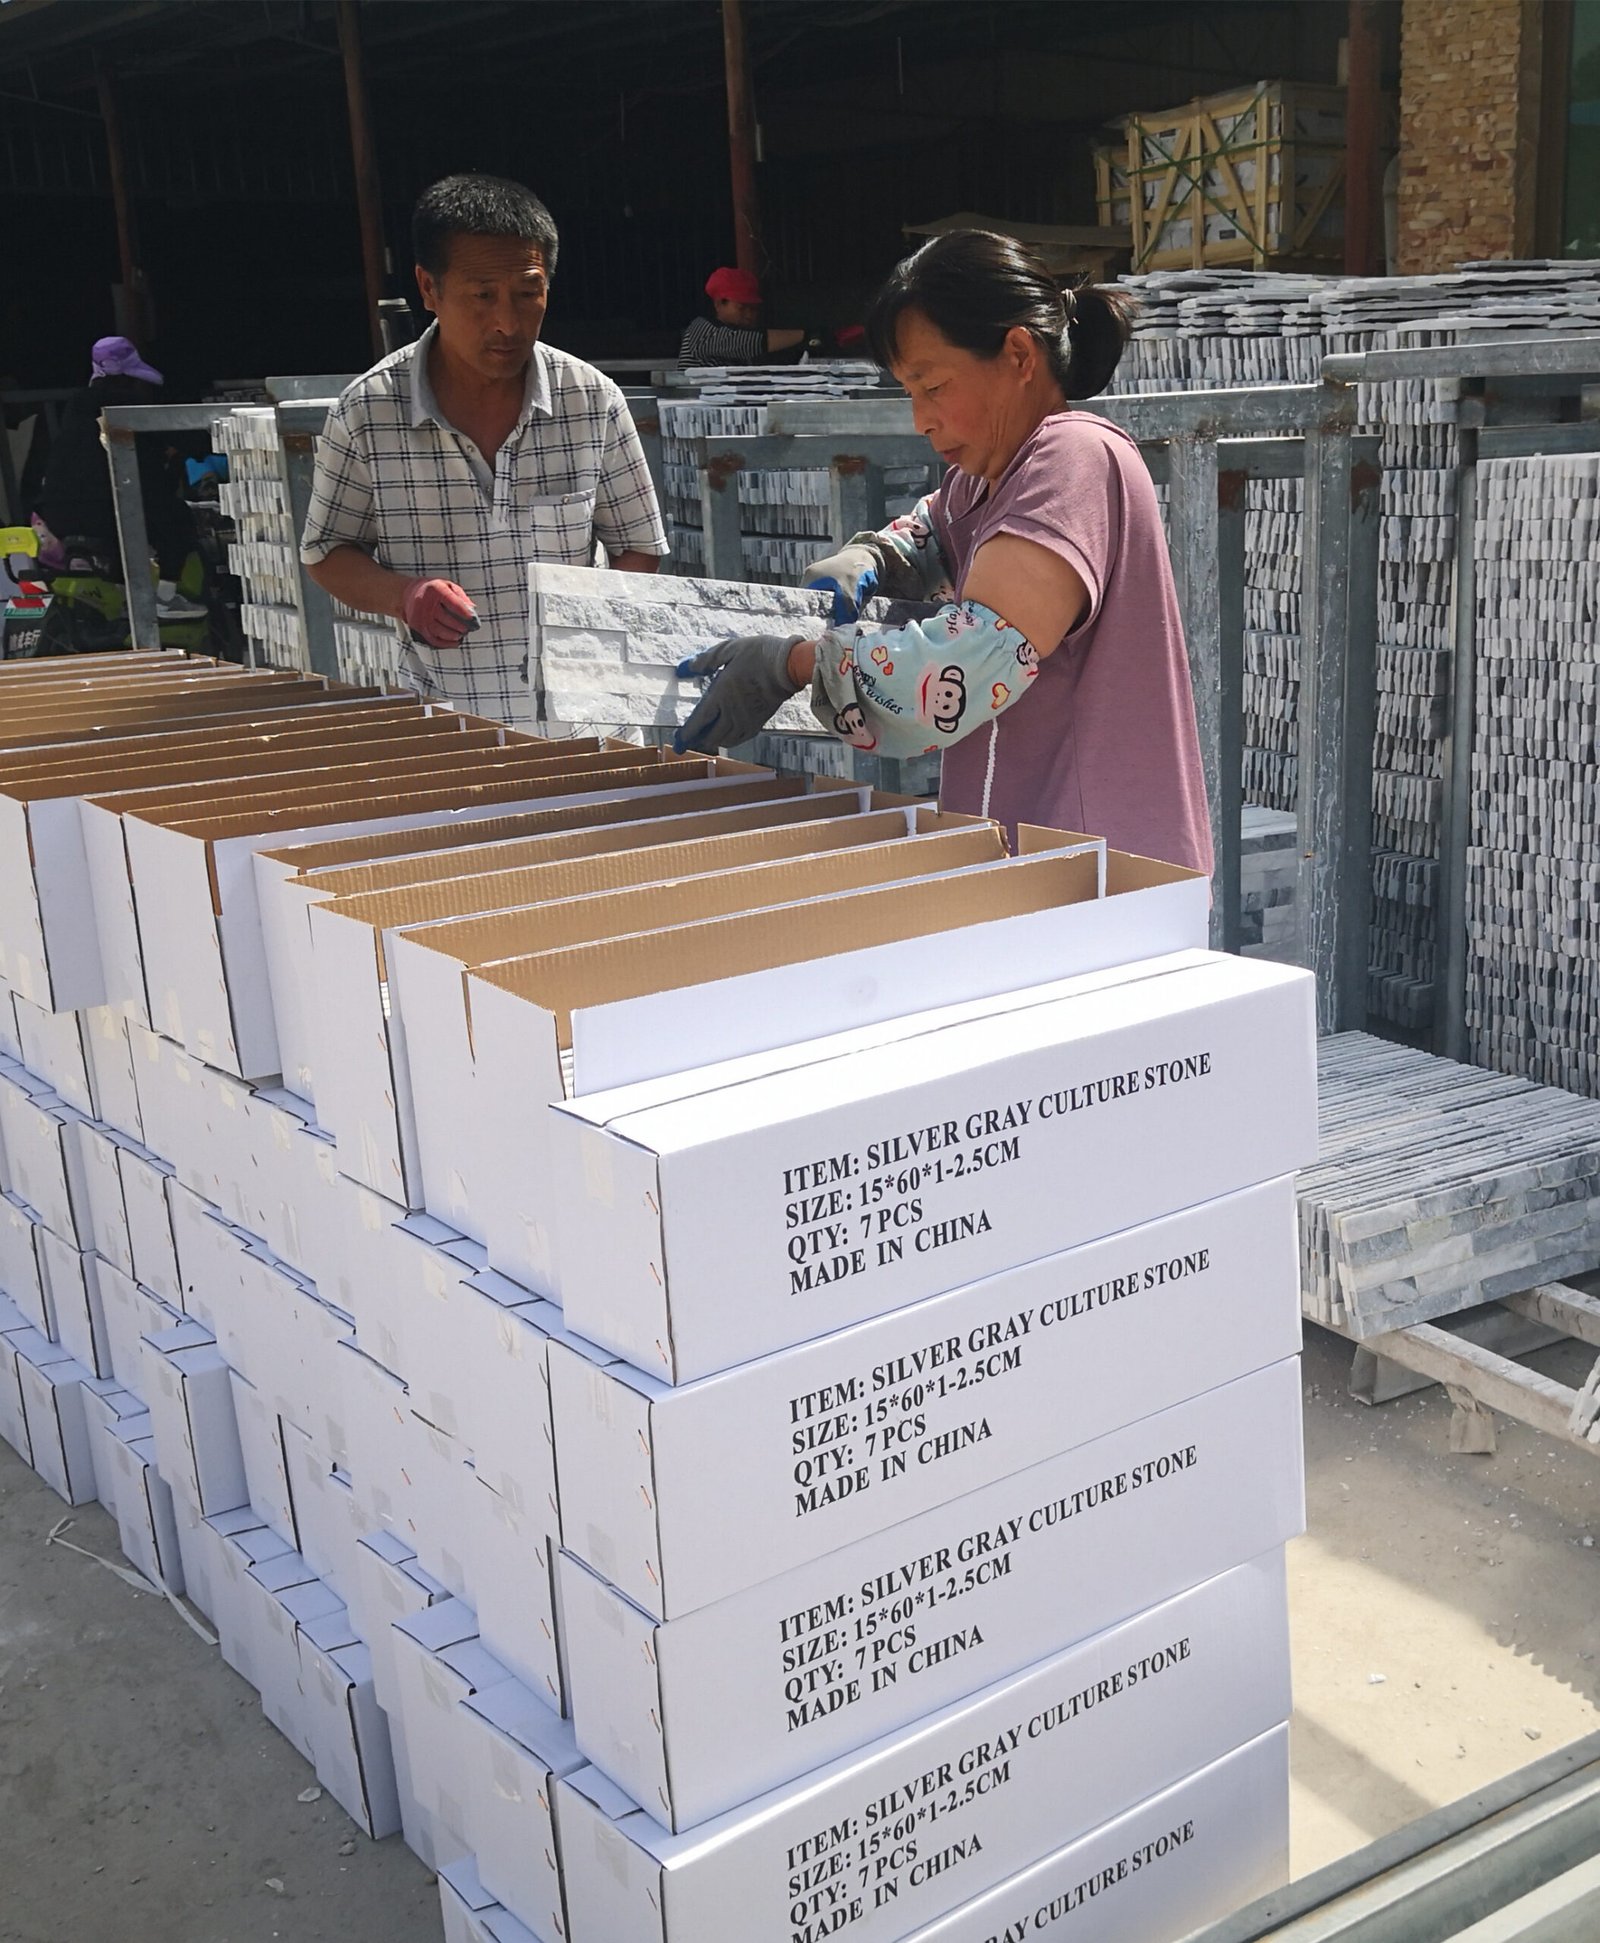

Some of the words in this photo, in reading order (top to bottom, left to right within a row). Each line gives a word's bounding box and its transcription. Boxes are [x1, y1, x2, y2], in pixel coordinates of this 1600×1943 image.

[866, 688, 903, 714] wishes
[783, 1153, 859, 1195] ITEM:
[867, 1121, 960, 1170] SILVER
[966, 1100, 1032, 1139] GRAY
[1039, 1071, 1139, 1118] CULTURE
[1145, 1053, 1210, 1089] STONE
[786, 1190, 852, 1229] SIZE:
[788, 1223, 848, 1264] QTY:
[878, 1198, 922, 1234] PCS
[789, 1249, 865, 1295] MADE
[877, 1236, 902, 1266] IN
[915, 1210, 992, 1252] CHINA
[790, 1377, 864, 1423] ITEM:
[873, 1337, 963, 1392] SILVER
[969, 1309, 1033, 1352] GRAY
[1040, 1272, 1139, 1326] CULTURE
[1144, 1249, 1209, 1289] STONE
[793, 1413, 857, 1455] SIZE:
[794, 1445, 853, 1487] QTY:
[882, 1413, 925, 1450] PCS
[795, 1467, 869, 1517] MADE
[881, 1451, 906, 1481] IN
[918, 1418, 992, 1464] CHINA
[779, 1594, 853, 1643] ITEM:
[861, 1548, 952, 1607] SILVER
[958, 1516, 1022, 1562] GRAY
[1029, 1473, 1127, 1532] CULTURE
[1132, 1445, 1196, 1489] STONE
[783, 1629, 847, 1673] SIZE:
[785, 1660, 843, 1703] QTY:
[872, 1625, 916, 1663] PCS
[787, 1680, 860, 1732] MADE
[872, 1662, 896, 1692] IN
[909, 1625, 984, 1673] CHINA
[787, 1818, 857, 1870] ITEM:
[866, 1763, 953, 1828] SILVER
[959, 1725, 1021, 1774] GRAY
[1028, 1672, 1123, 1738] CULTURE
[1128, 1638, 1190, 1687] STONE
[789, 1852, 851, 1899] SIZE:
[791, 1881, 846, 1926] QTY:
[876, 1840, 917, 1879] PCS
[792, 1897, 862, 1943] MADE
[875, 1877, 897, 1908] IN
[910, 1834, 982, 1886] CHINA
[985, 1916, 1028, 1943] AY
[1035, 1859, 1127, 1928] CULTURE
[1133, 1820, 1193, 1871] STONE
